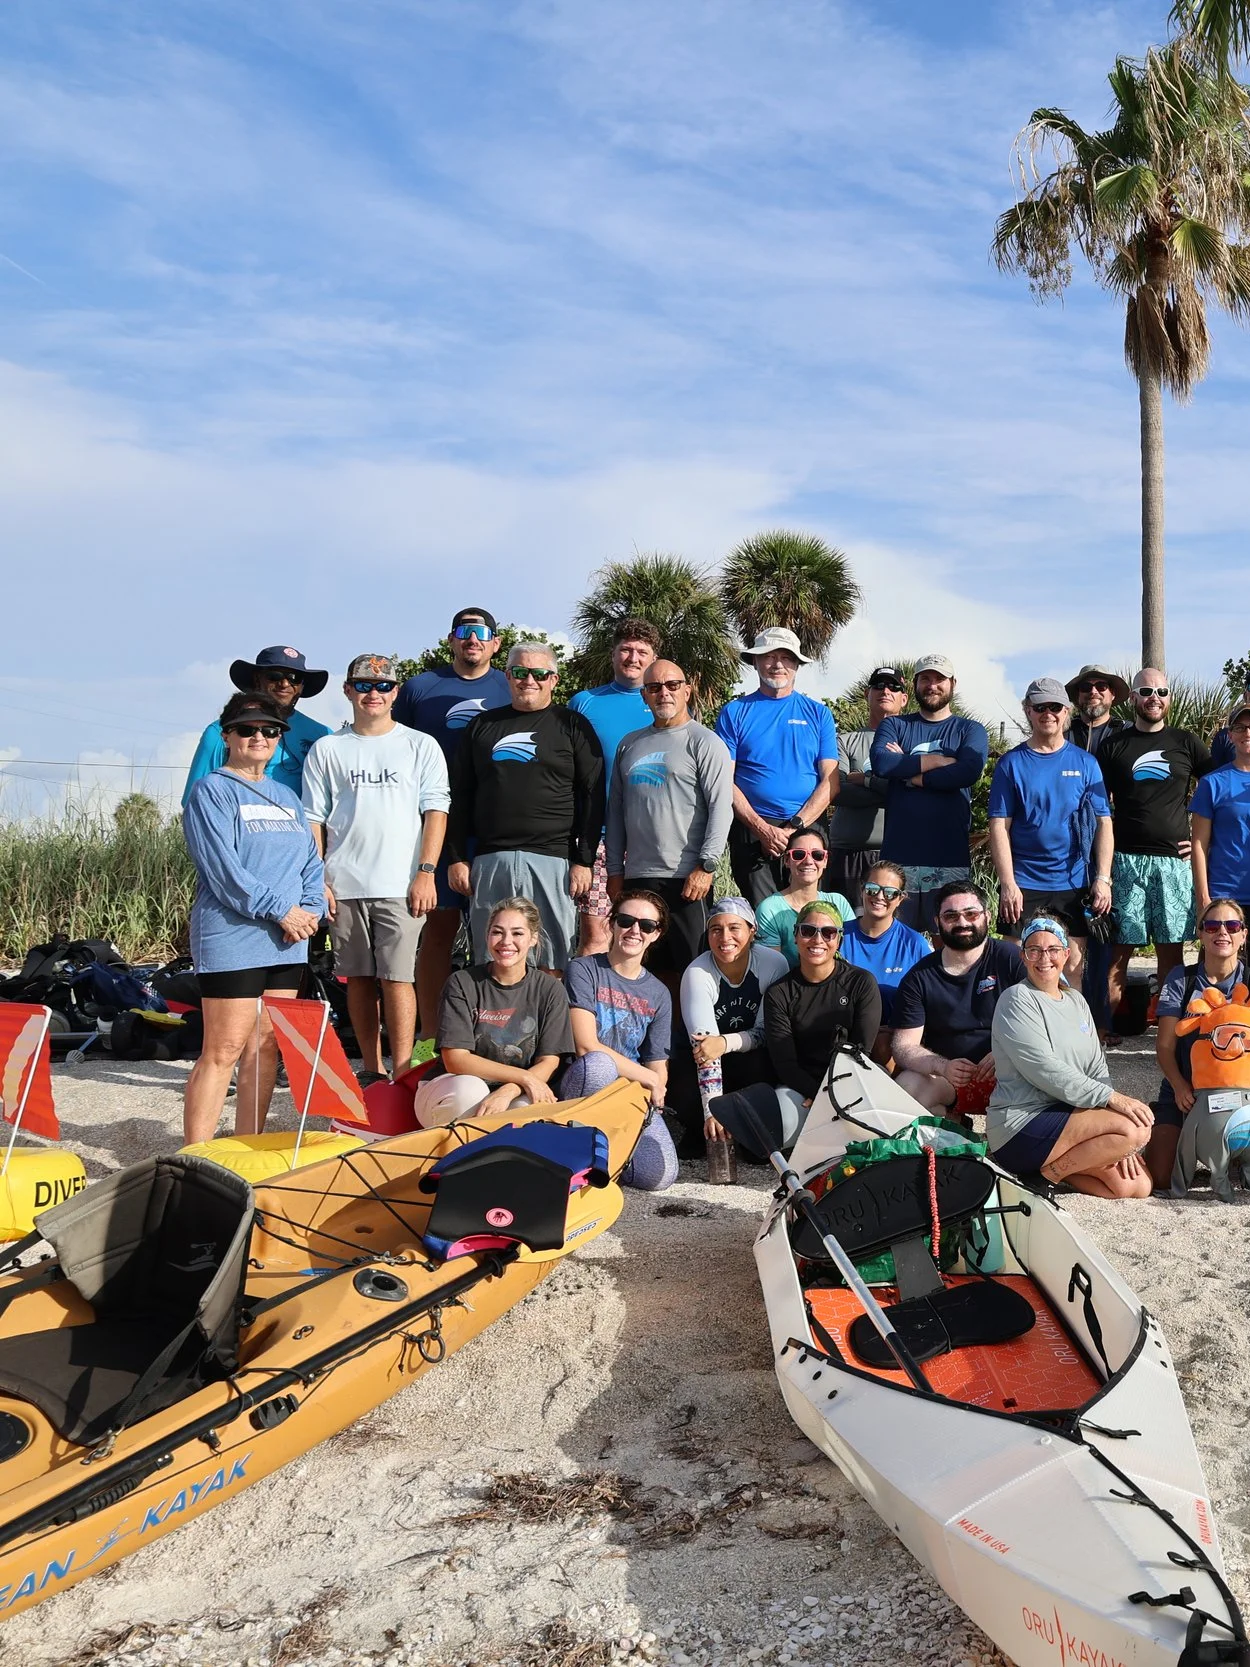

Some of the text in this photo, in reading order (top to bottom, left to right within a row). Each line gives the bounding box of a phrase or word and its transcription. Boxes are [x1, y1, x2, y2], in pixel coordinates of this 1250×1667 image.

[714, 1004, 728, 1020] URF
[1048, 1343, 1080, 1365] ORU
[139, 1451, 254, 1535] KAYAK
[957, 1518, 1011, 1555] MADE IN USA
[1022, 1606, 1055, 1645] ORU
